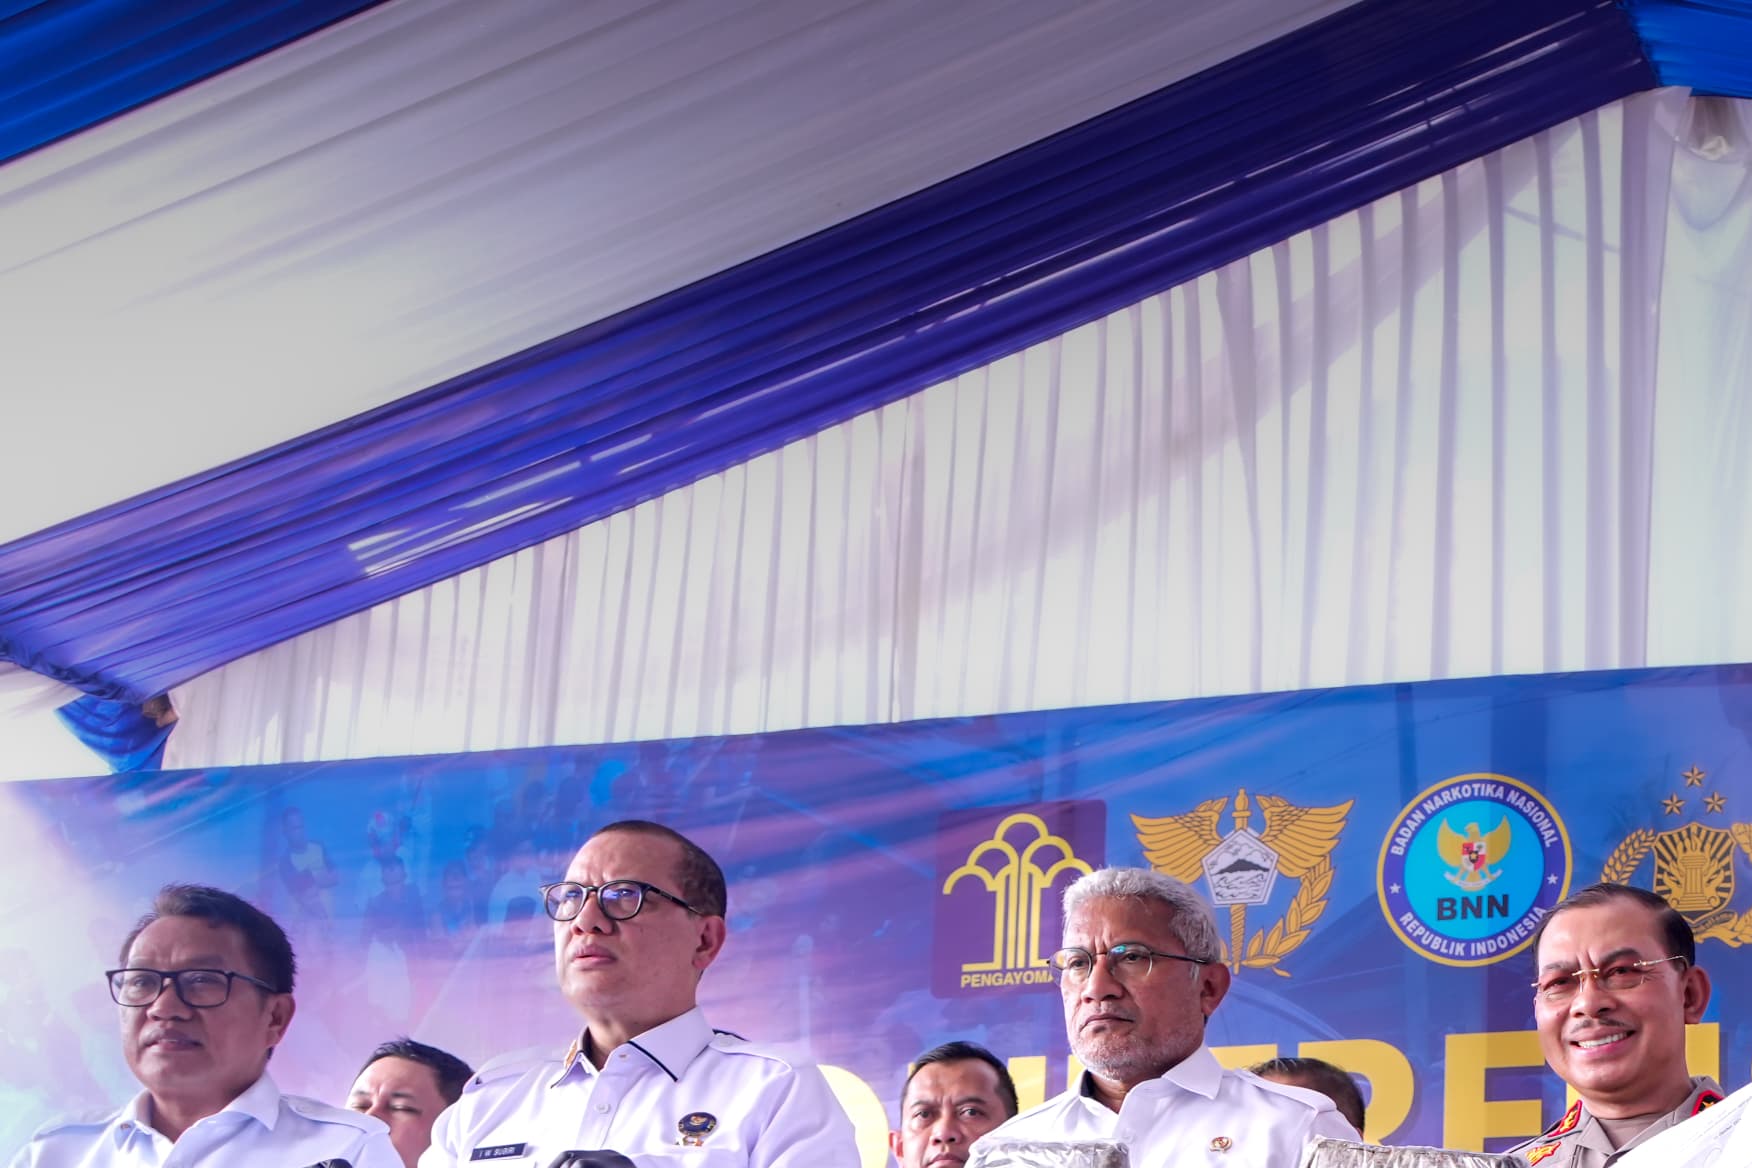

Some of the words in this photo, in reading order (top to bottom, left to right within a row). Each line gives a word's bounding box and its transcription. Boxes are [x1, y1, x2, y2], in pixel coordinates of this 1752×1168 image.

[1390, 810, 1426, 856] BADAN
[1423, 783, 1505, 814] NARKOTIKA
[1506, 789, 1559, 848] NASIONAL
[1399, 911, 1465, 956] REPUBLIK
[1470, 905, 1547, 956] INDONESIA
[1437, 893, 1510, 921] BNN
